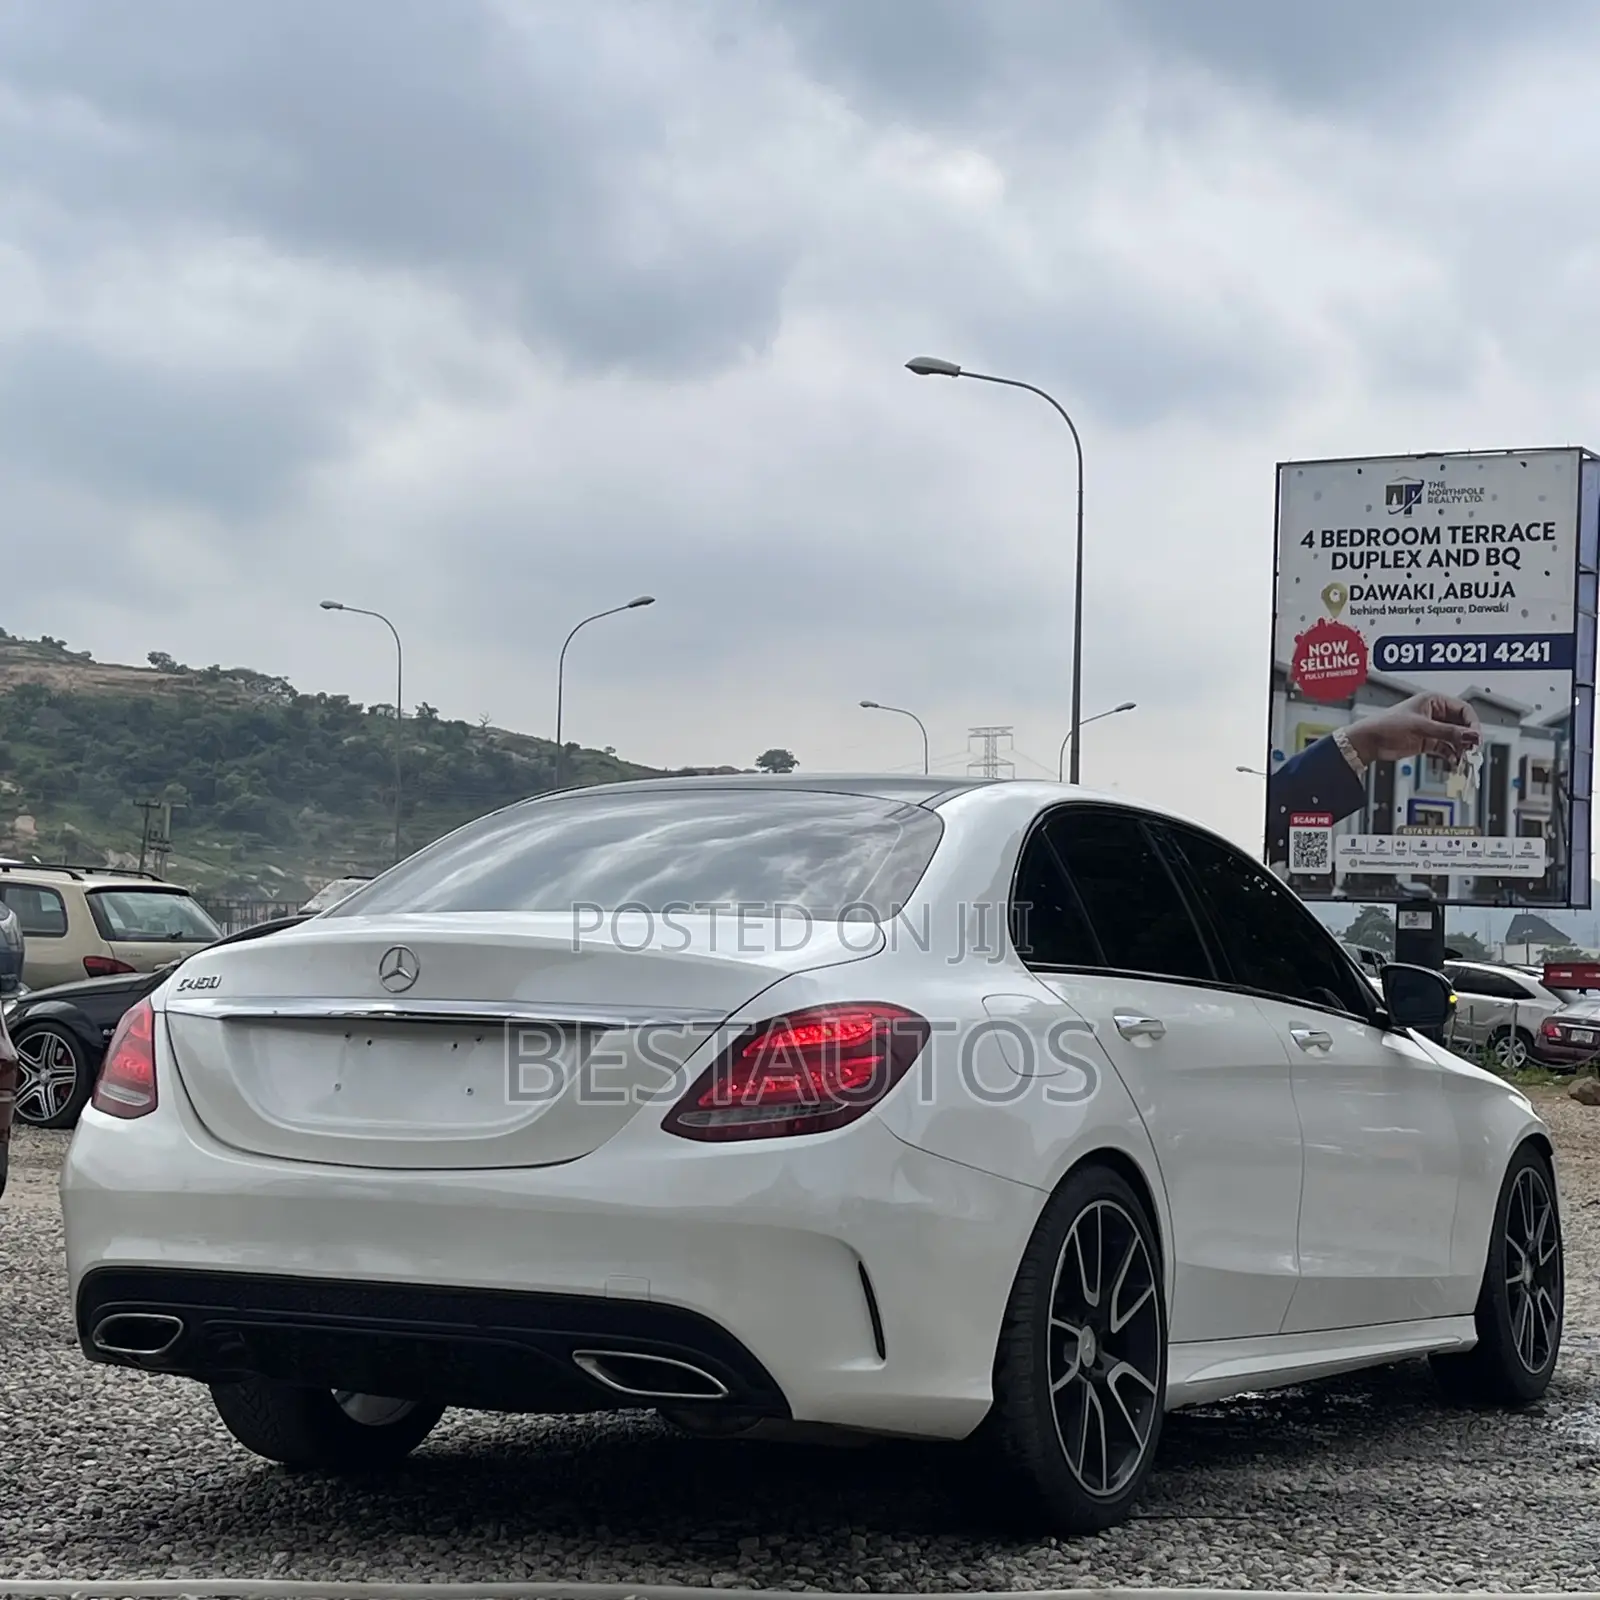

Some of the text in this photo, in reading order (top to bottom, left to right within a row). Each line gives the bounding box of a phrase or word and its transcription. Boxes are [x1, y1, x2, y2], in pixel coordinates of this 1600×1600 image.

[1427, 487, 1485, 497] NORTHPOLE
[1428, 481, 1446, 489] THE
[1427, 494, 1483, 504] REALTY LTD.
[1300, 522, 1556, 549] 4 BEDROOM TERRACE
[1331, 546, 1521, 570] DUPLEX AND BQ
[1349, 583, 1434, 602] DAWAKI
[1350, 603, 1509, 616] behind Market Square, Dawaki
[1308, 640, 1349, 657] NOW
[1383, 641, 1550, 664] 091 2021 4241
[1300, 652, 1360, 672] SELLING
[1293, 816, 1316, 825] SCAN
[1402, 828, 1432, 836] ESTATE
[177, 976, 222, 992] C450
